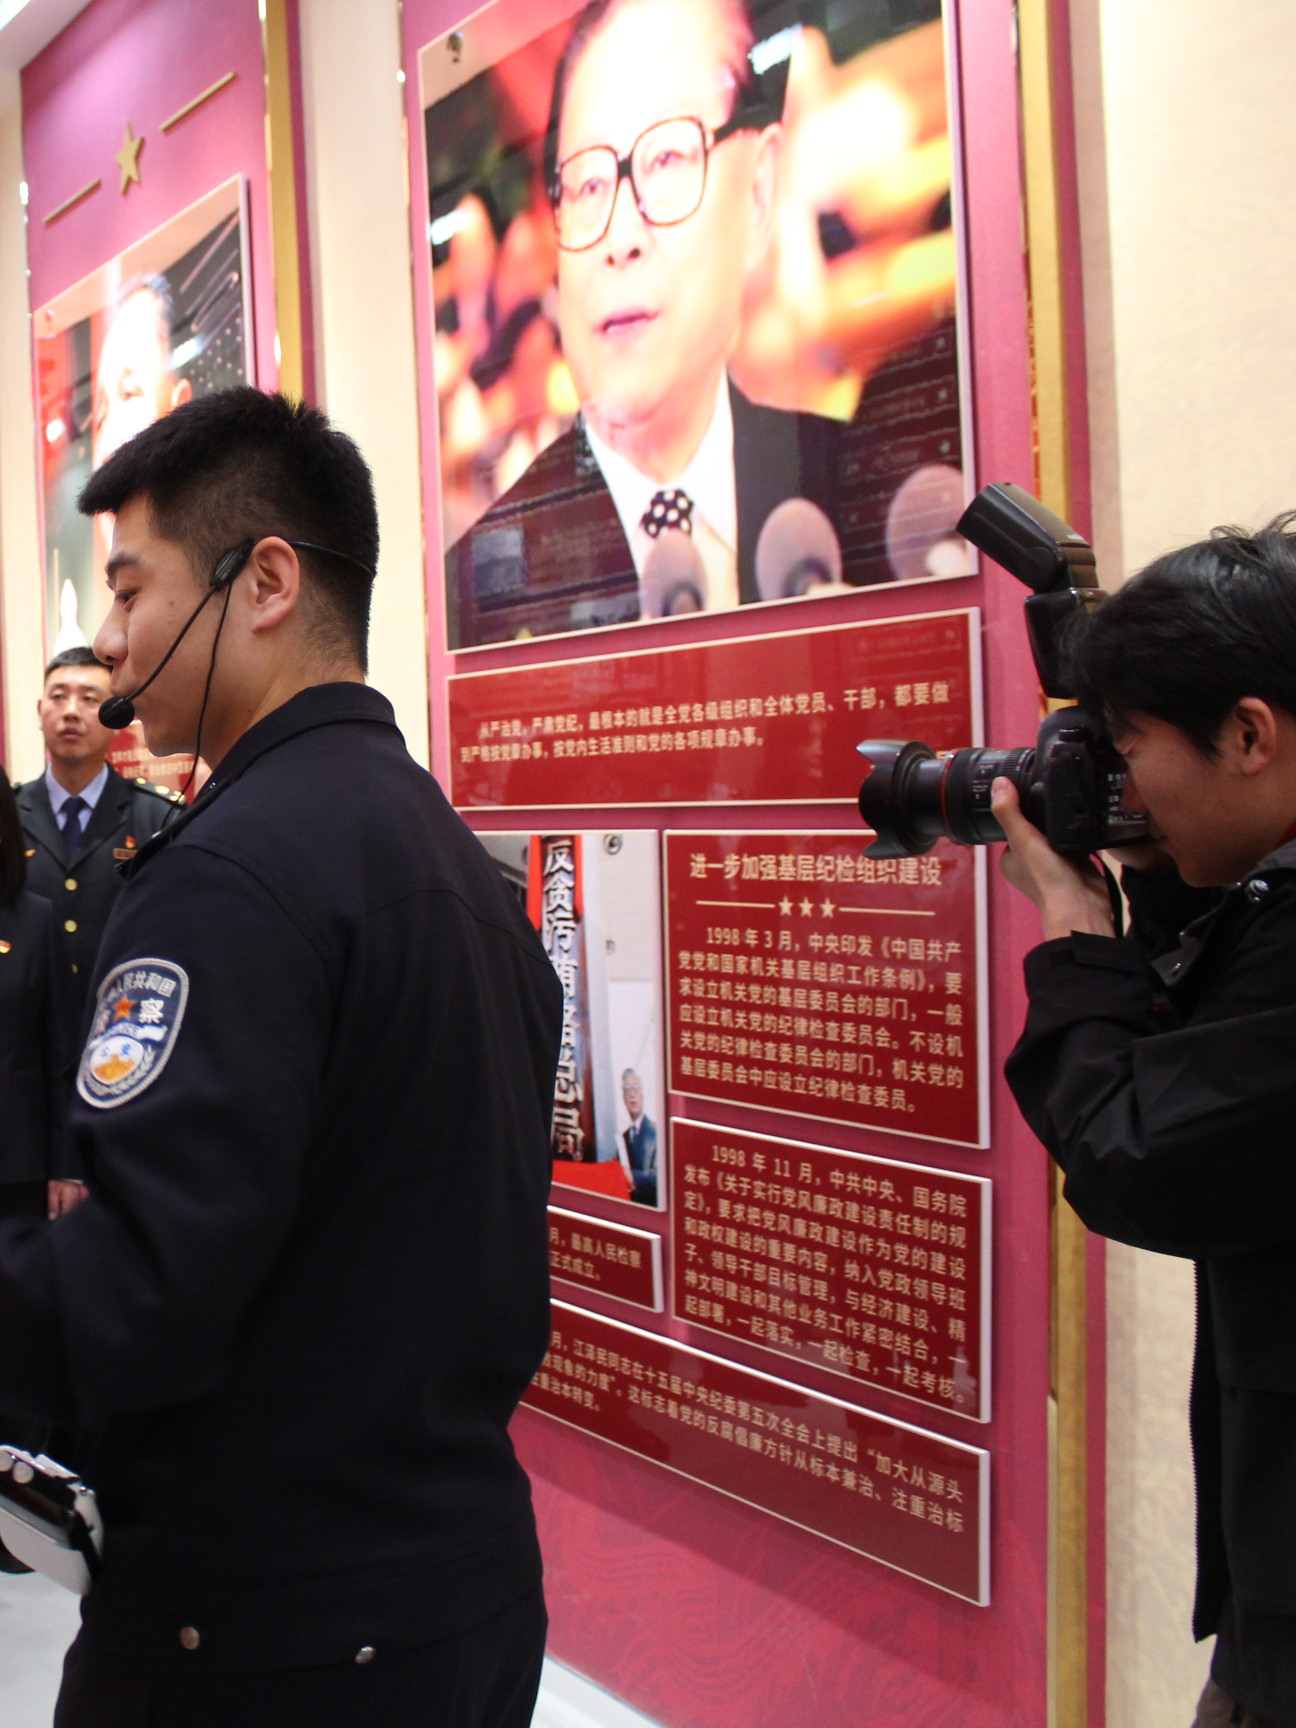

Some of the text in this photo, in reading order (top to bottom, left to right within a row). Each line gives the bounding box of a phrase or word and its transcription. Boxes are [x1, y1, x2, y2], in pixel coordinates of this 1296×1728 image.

[690, 853, 943, 886] 进一步加强基层纪检组织建设
[679, 977, 964, 1026] 求设立机关党的基层委员会的部门，一般
[679, 1003, 964, 1058] 应设立机关党的纪律检查委员会。不设机
[680, 1029, 964, 1089] 关党的纪律检查委员会的部门，机关党的
[680, 1056, 916, 1113] 基层委员会中应设立纪律检查委员。
[684, 1216, 967, 1312] 和政权建设的重要内容，纳入党政领导班
[684, 1243, 966, 1342] 子、领导干部目标管理，与经济建设、精
[685, 1295, 964, 1404] 起部署，一起落实，一起检查，一起考核。
